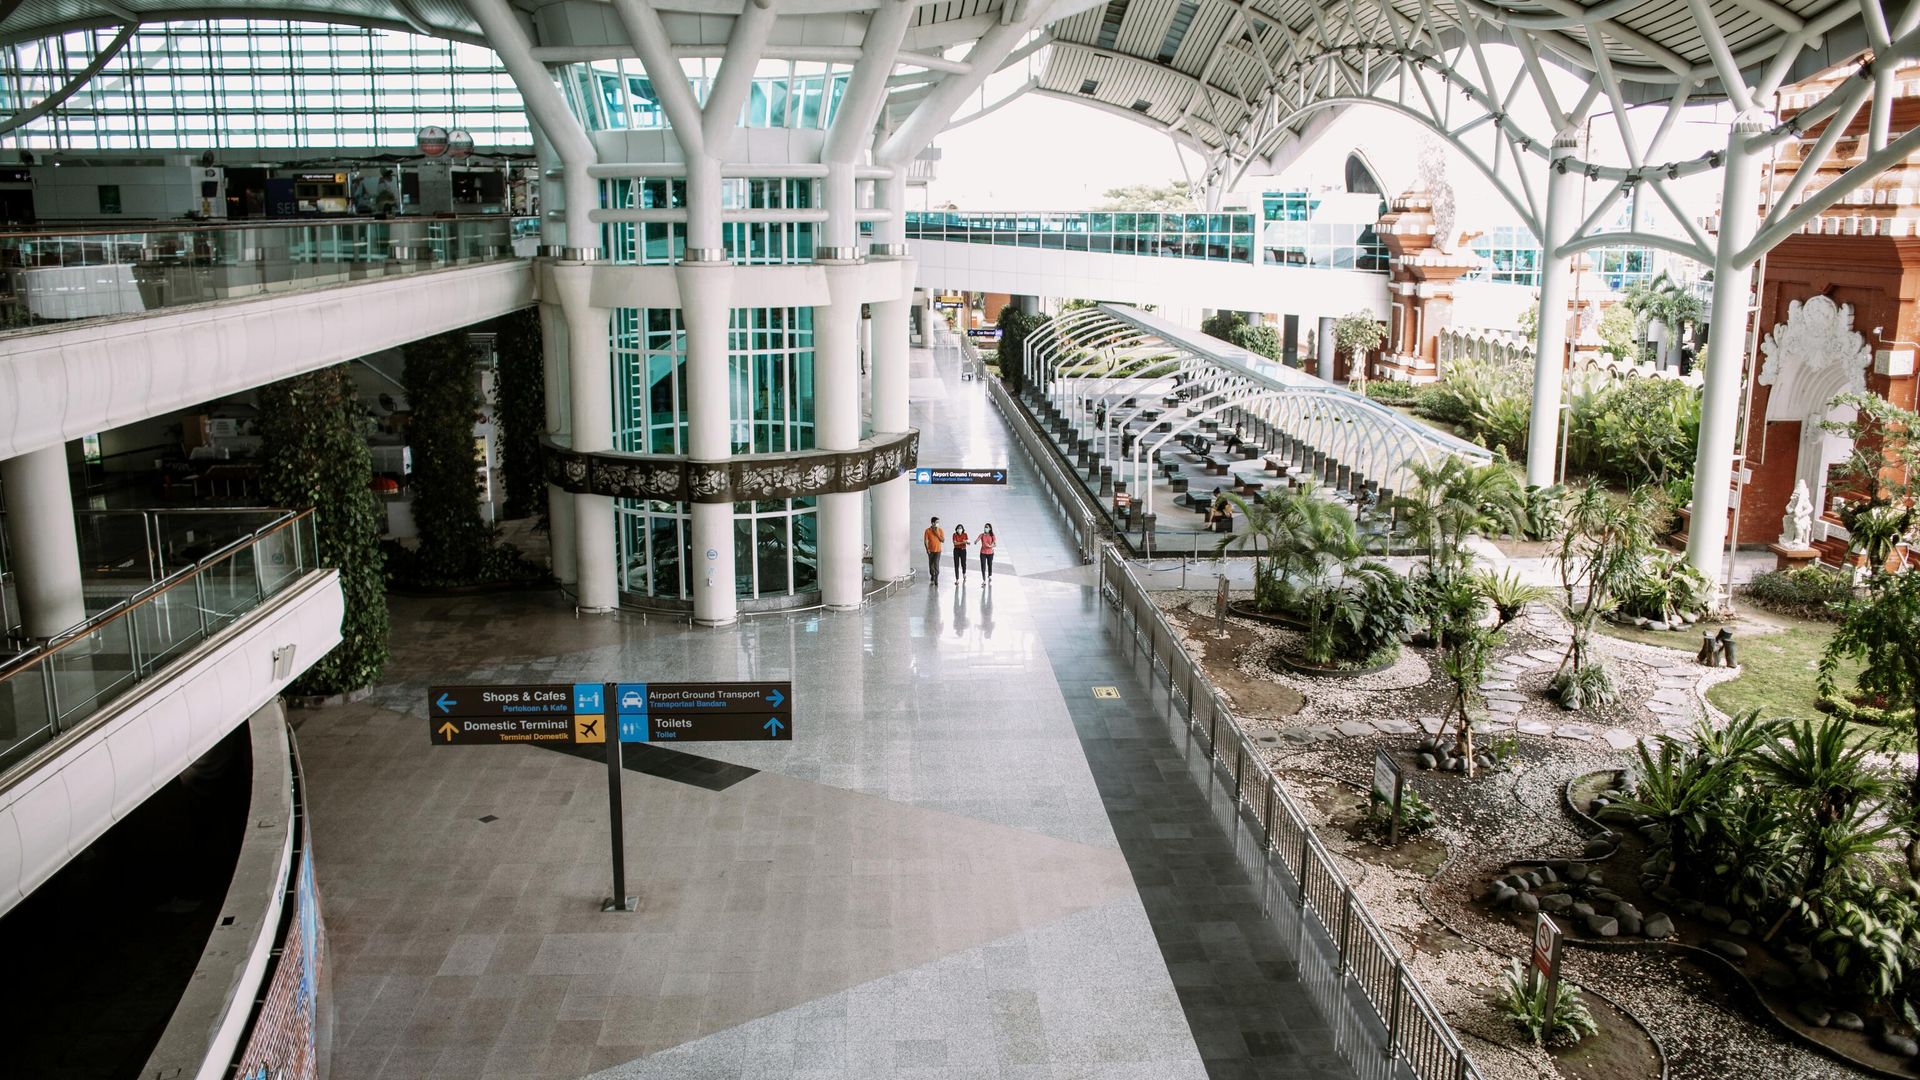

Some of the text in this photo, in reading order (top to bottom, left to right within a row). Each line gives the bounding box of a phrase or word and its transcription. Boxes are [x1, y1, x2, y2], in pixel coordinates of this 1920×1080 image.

[483, 691, 566, 703] Shops & Cafes
[649, 690, 760, 701] Airport Ground Transport
[503, 704, 541, 712] Pertokoan
[650, 700, 727, 709] Transportasi Bandara
[464, 719, 568, 731] Domestic Terminal
[655, 719, 692, 728] Toilets
[500, 732, 568, 741] Terminal Domestik
